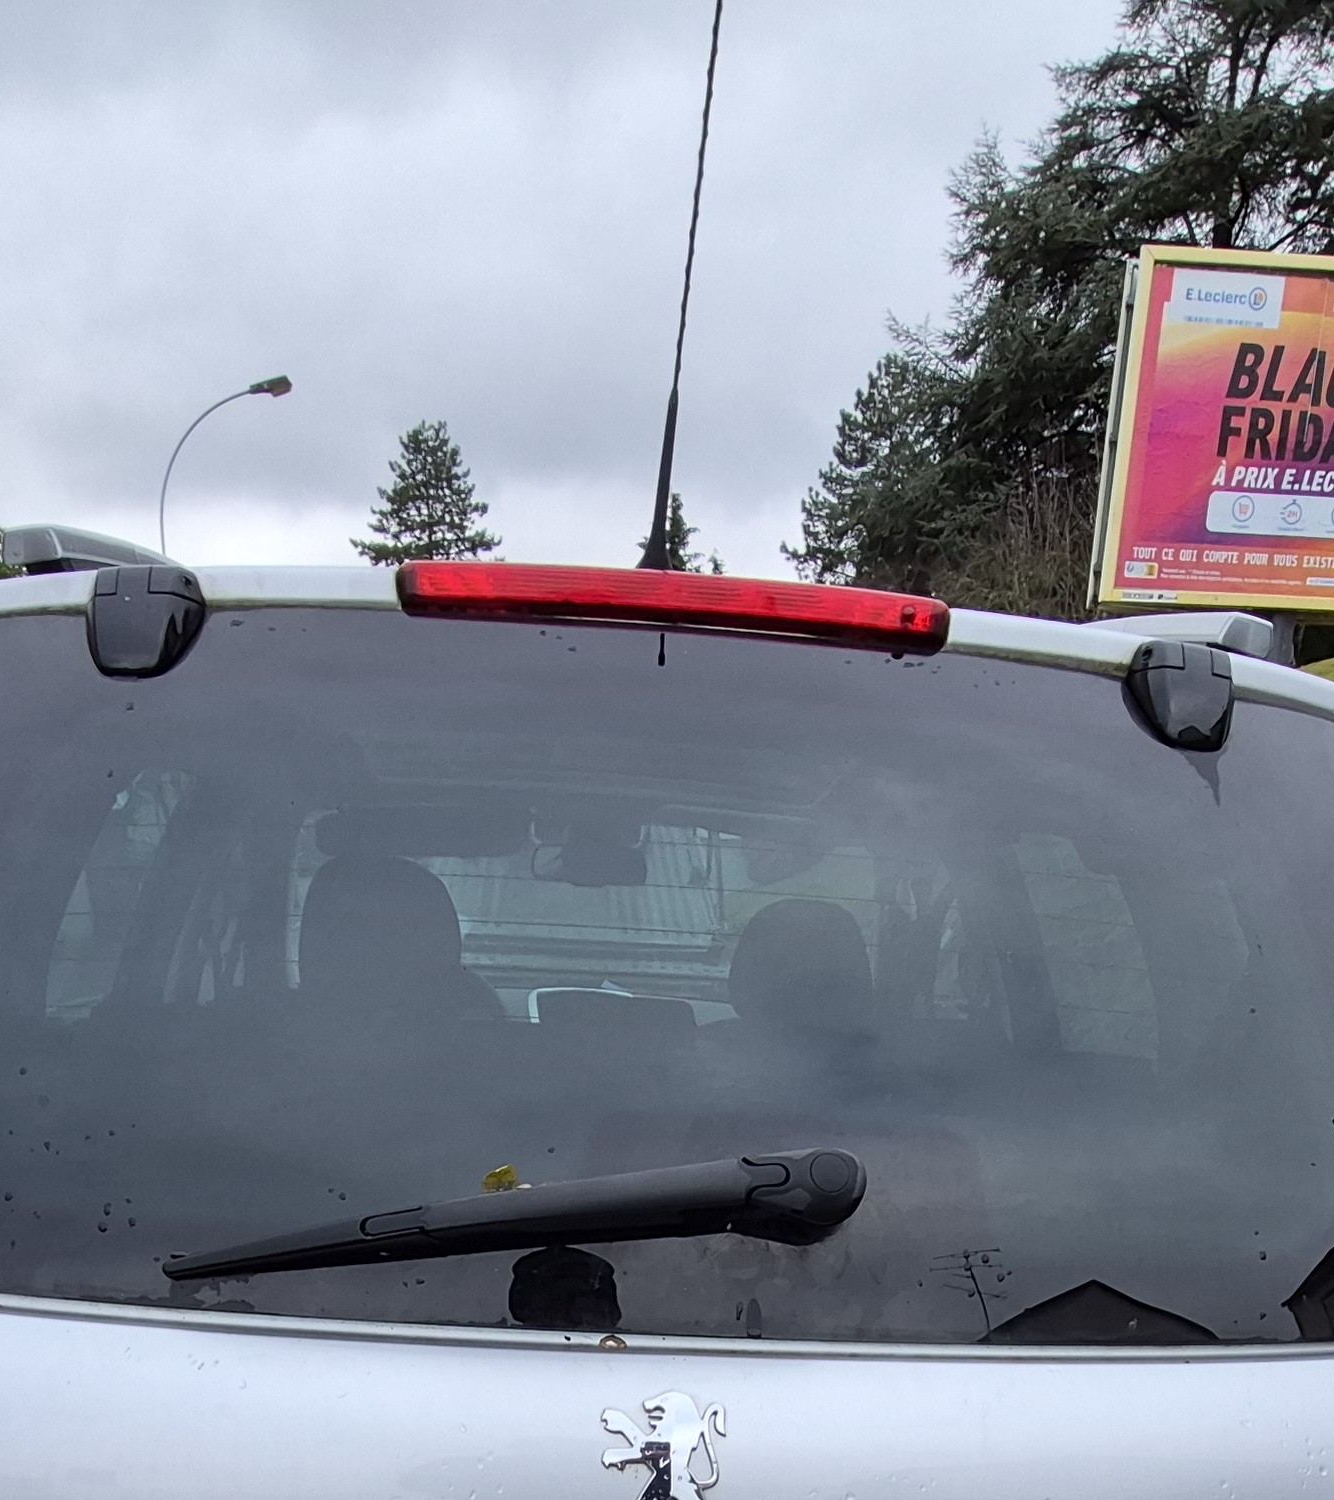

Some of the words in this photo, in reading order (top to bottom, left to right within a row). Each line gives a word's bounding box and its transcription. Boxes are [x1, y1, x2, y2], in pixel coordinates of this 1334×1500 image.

[1185, 288, 1247, 305] E.Leclerc
[1212, 459, 1227, 486] À
[1231, 466, 1280, 490] PRIX
[1133, 547, 1158, 560] TOUT
[1162, 548, 1175, 561] CE
[1179, 550, 1198, 563] QUI
[1203, 551, 1239, 564] COMPTE
[1244, 553, 1269, 566] POUR
[1273, 554, 1298, 567] VOUS
